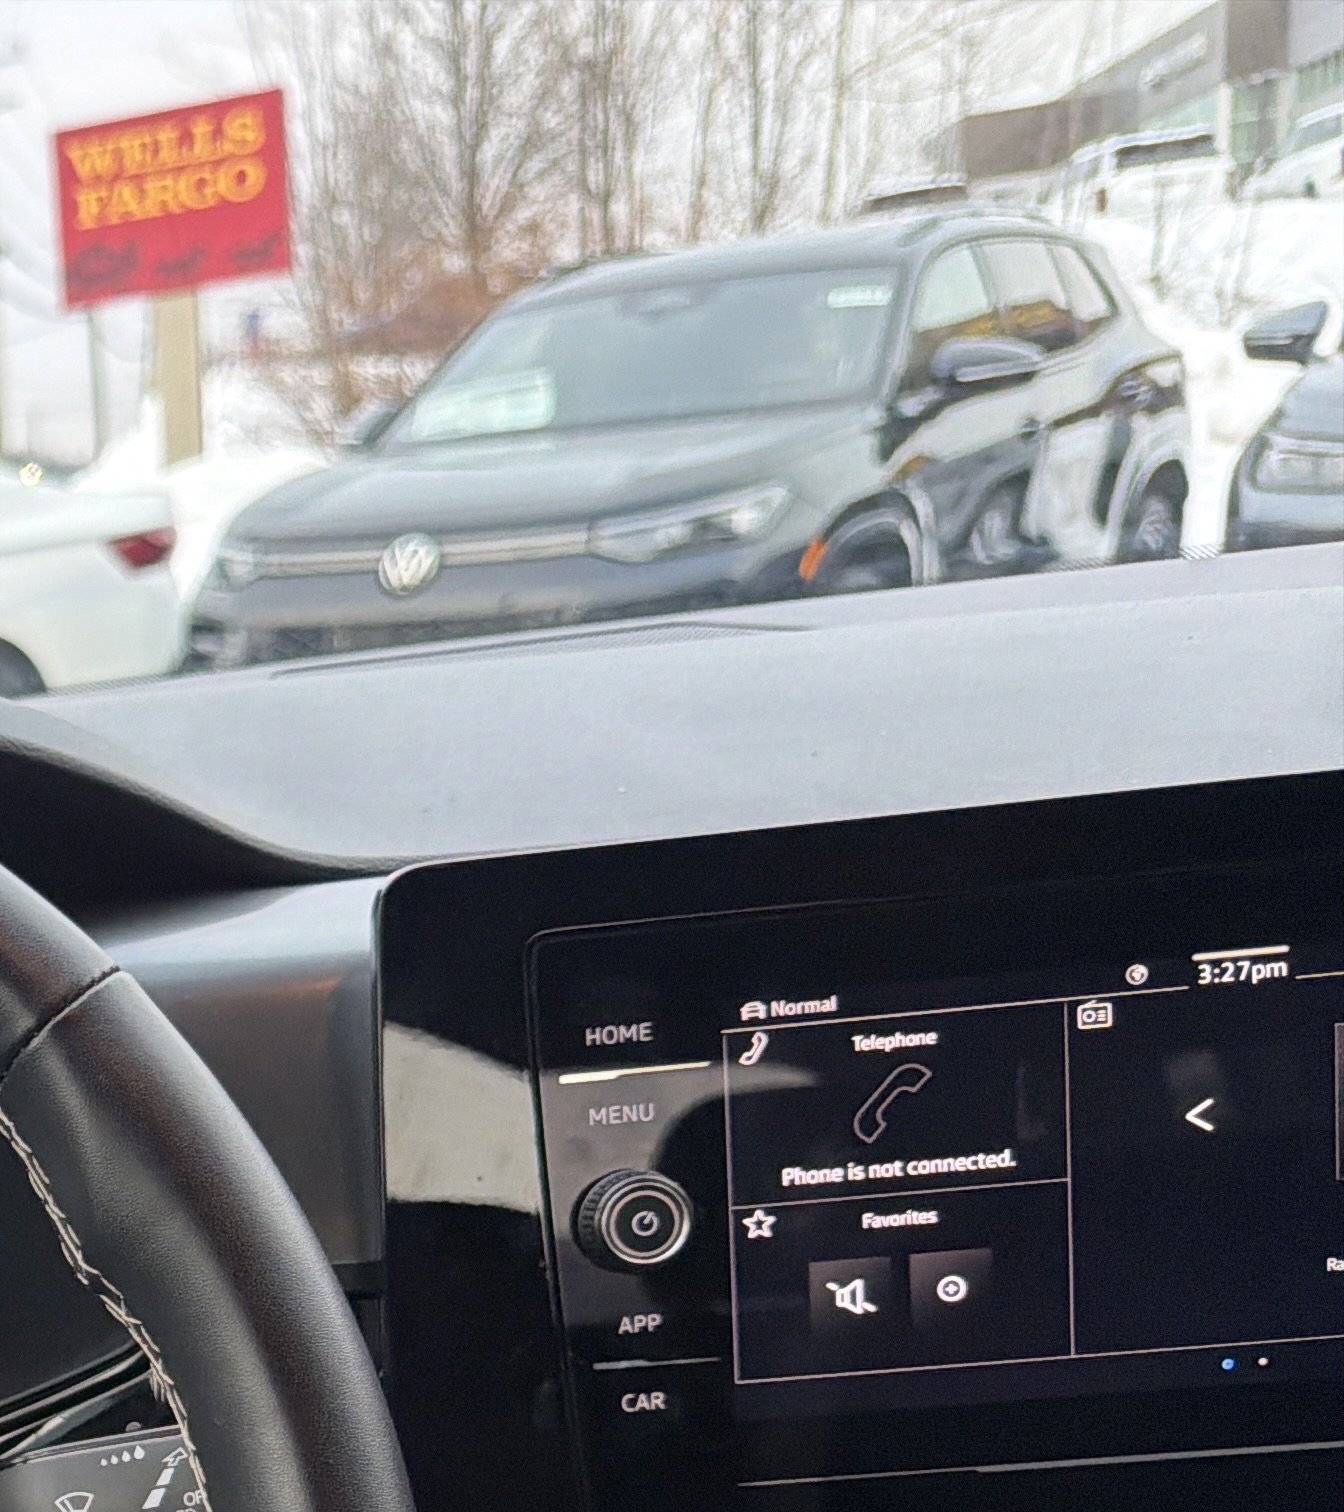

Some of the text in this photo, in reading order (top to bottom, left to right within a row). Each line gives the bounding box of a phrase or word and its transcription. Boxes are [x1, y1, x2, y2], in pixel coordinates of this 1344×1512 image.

[67, 104, 266, 181] WELLS
[75, 157, 268, 232] FARGO
[1197, 961, 1289, 985] 3:27pm
[770, 995, 838, 1018] Normal
[585, 1021, 654, 1047] HOME
[851, 1031, 939, 1052] Telephone
[588, 1103, 656, 1126] MENU
[781, 1148, 1018, 1187] Phone is not connected.
[861, 1209, 940, 1230] Favorites
[618, 1313, 664, 1335] APP
[621, 1391, 666, 1413] CAR
